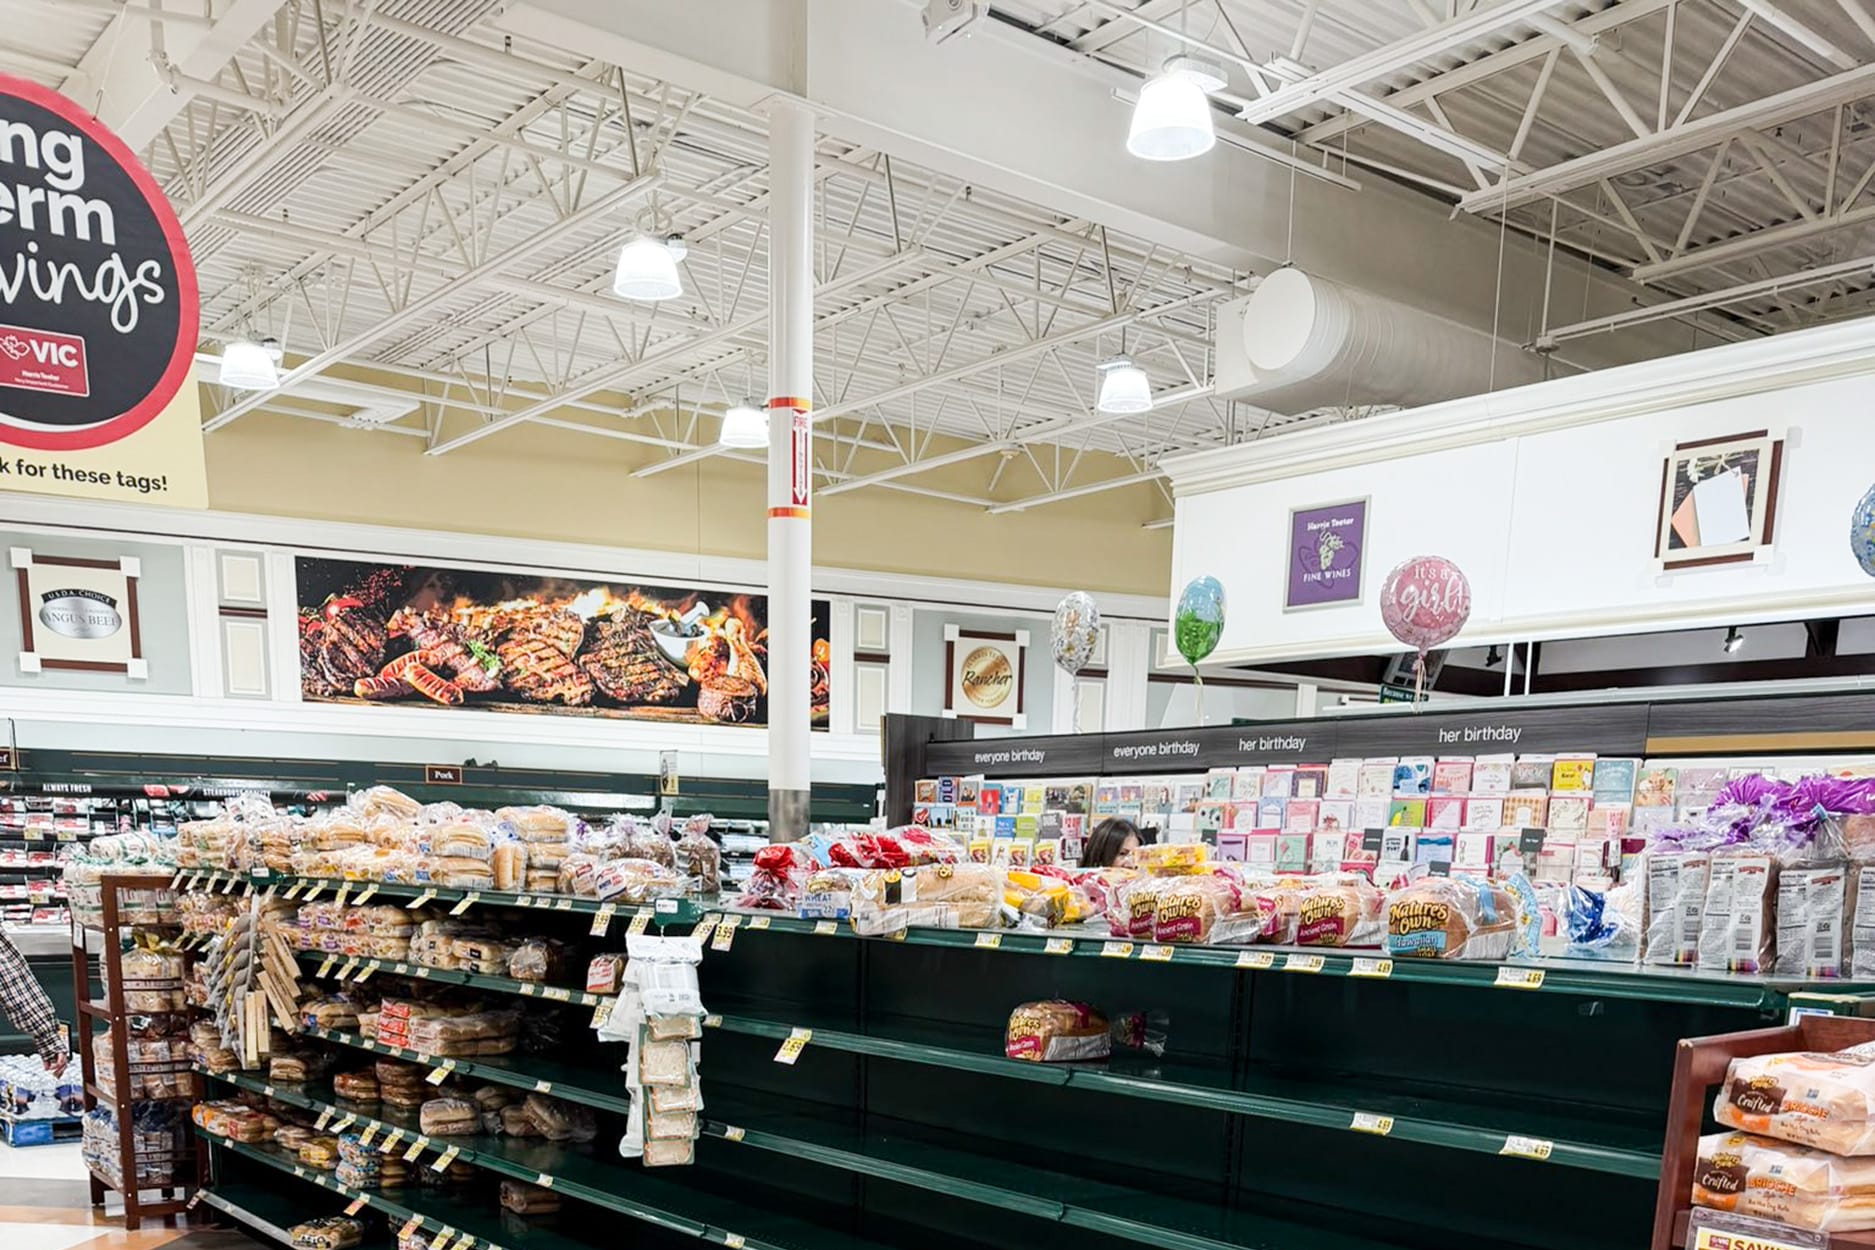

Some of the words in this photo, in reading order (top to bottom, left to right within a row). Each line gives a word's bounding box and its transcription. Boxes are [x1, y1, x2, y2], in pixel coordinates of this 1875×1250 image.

[0, 119, 85, 191] ng
[0, 182, 116, 246] erm
[0, 241, 164, 334] vings
[29, 338, 79, 368] VIC
[16, 458, 47, 477] for
[52, 463, 111, 485] these
[116, 471, 168, 494] tags!
[1303, 571, 1322, 582] FINE
[1324, 568, 1351, 579] WINES
[962, 671, 1013, 687] Rancher
[1439, 728, 1461, 743] her
[1464, 725, 1521, 743] birthday
[1113, 744, 1157, 759] everyone
[1158, 741, 1200, 757] birthday
[1239, 738, 1257, 751] her
[1259, 736, 1306, 752] birthday
[974, 752, 1010, 765] everyone
[1011, 749, 1045, 764] birthday
[434, 770, 454, 780] Pork
[42, 784, 69, 793] ALWAYS
[70, 784, 93, 793] FRESH
[804, 893, 832, 902] WHEAT
[1160, 905, 1188, 924] Own
[1304, 908, 1332, 925] Own
[1389, 902, 1448, 925] Nature's
[1399, 915, 1432, 935] Own
[1737, 1094, 1775, 1113] Crafted
[1783, 1100, 1830, 1121] BRIOCHE
[1702, 1174, 1739, 1191] Crafted
